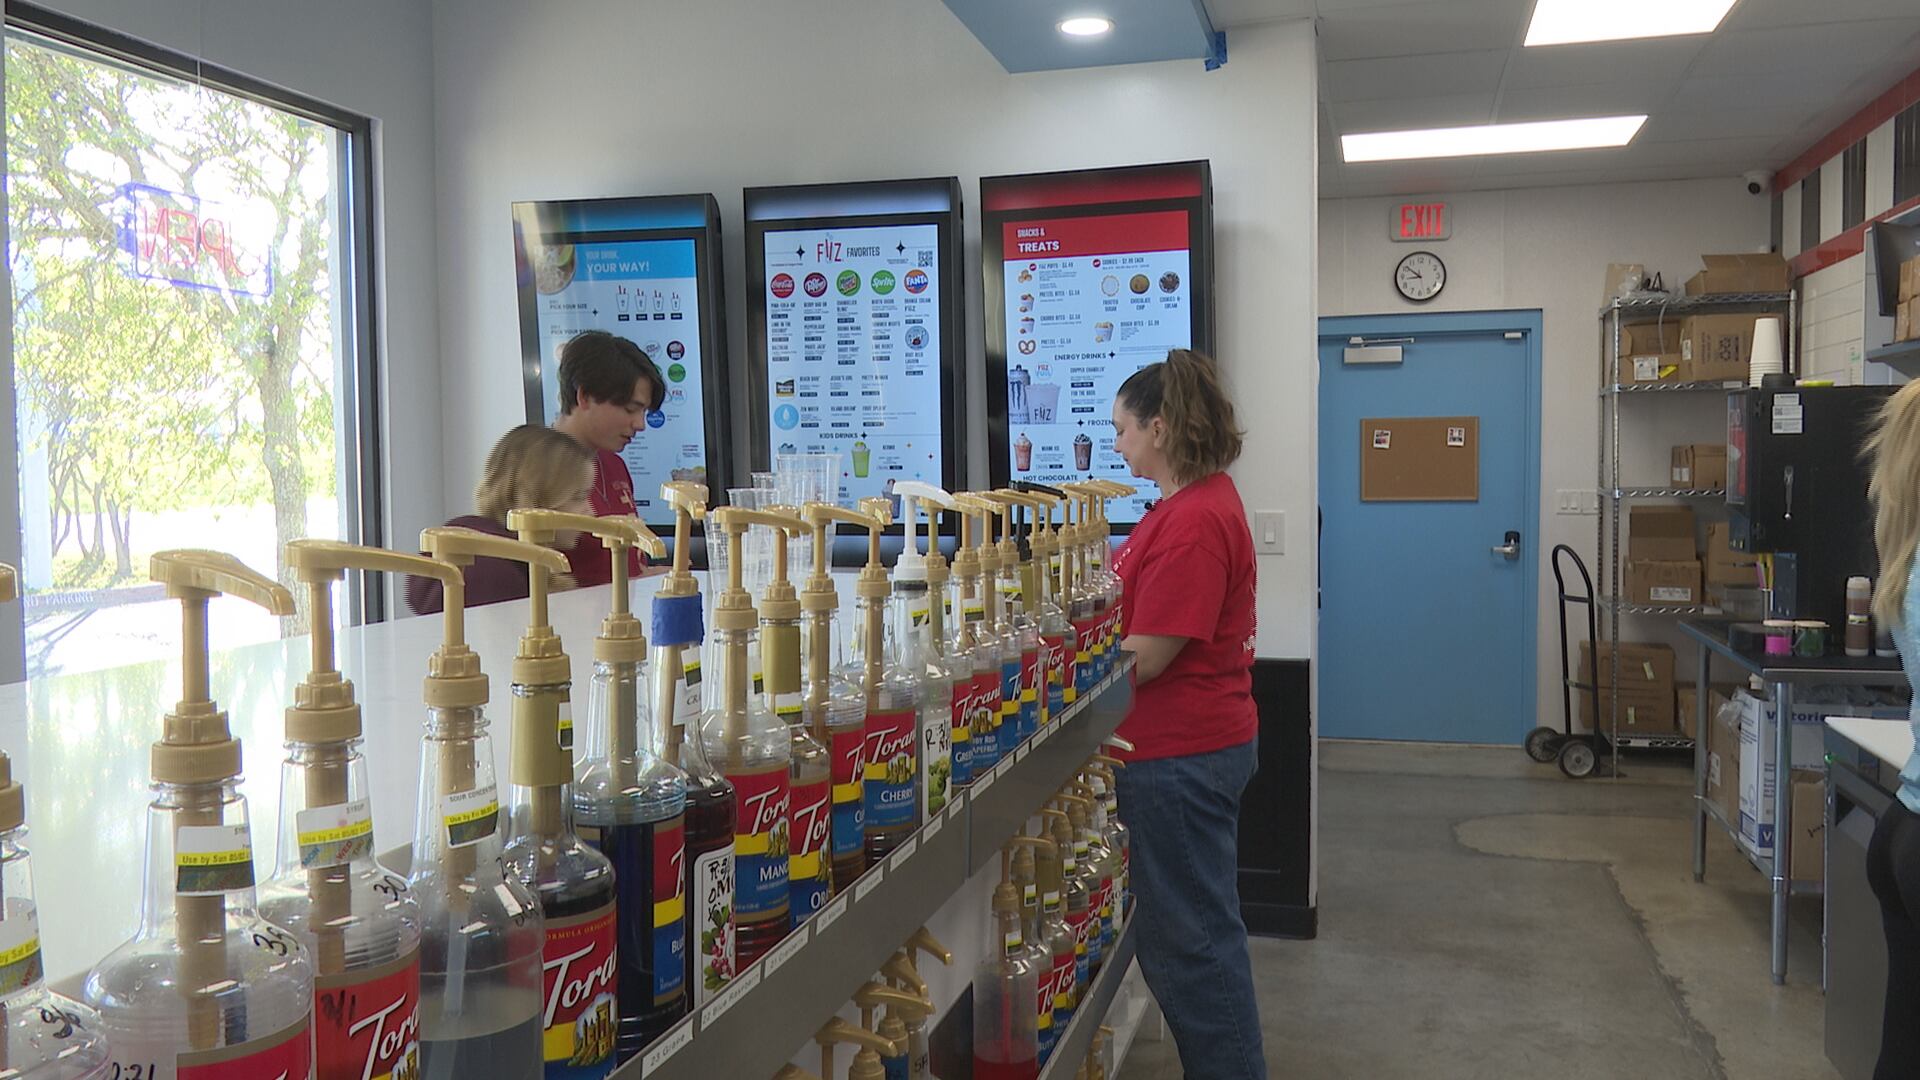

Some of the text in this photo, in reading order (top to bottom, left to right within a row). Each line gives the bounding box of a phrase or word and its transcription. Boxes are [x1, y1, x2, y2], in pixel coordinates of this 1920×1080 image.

[1401, 204, 1444, 237] EXIT
[846, 246, 881, 258] FAVORITES
[1018, 241, 1060, 253] TREATS
[586, 261, 650, 274] YOUR WAY!
[880, 788, 914, 804] CHERRY
[182, 855, 198, 865] Use
[200, 854, 210, 866] by
